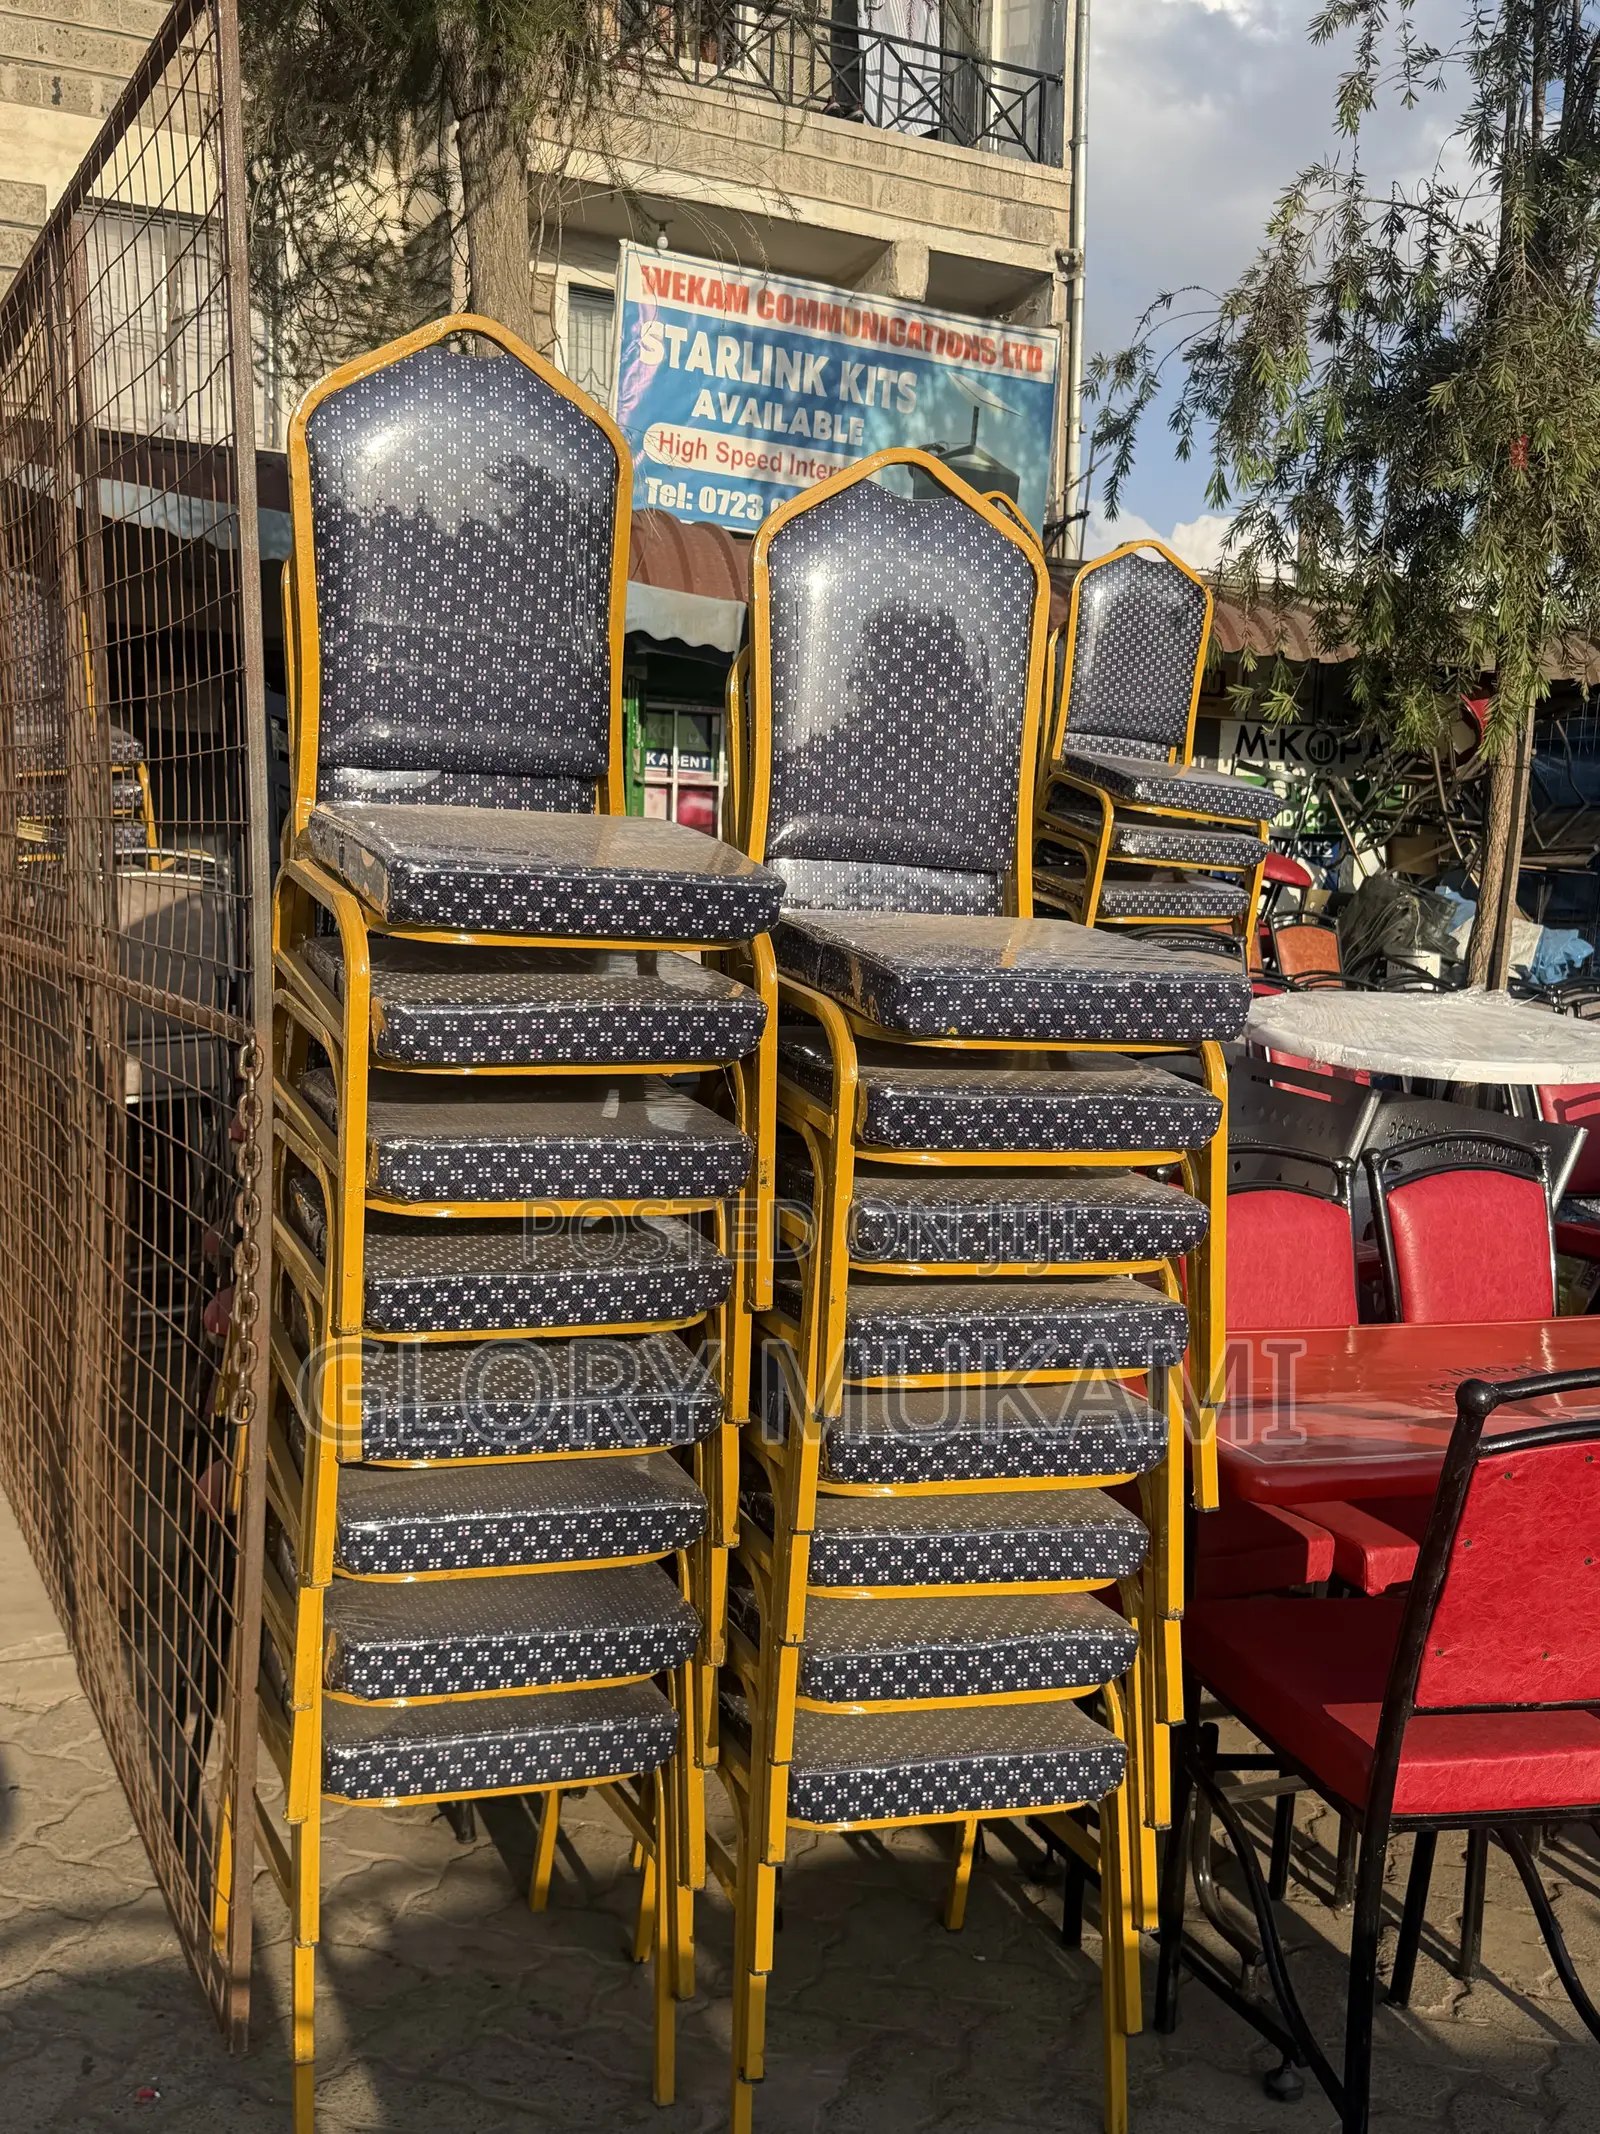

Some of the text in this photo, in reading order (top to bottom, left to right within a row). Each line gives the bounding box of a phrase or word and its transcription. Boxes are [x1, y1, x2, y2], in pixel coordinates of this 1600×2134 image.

[641, 264, 1043, 373] WEKAM COMMUNICATIONS LTD
[639, 320, 917, 415] STARLINK KITS
[691, 389, 866, 447] AVAILABLE
[659, 431, 846, 480] High Speed Inter
[645, 477, 694, 511] Tel:
[698, 486, 764, 521] 0723
